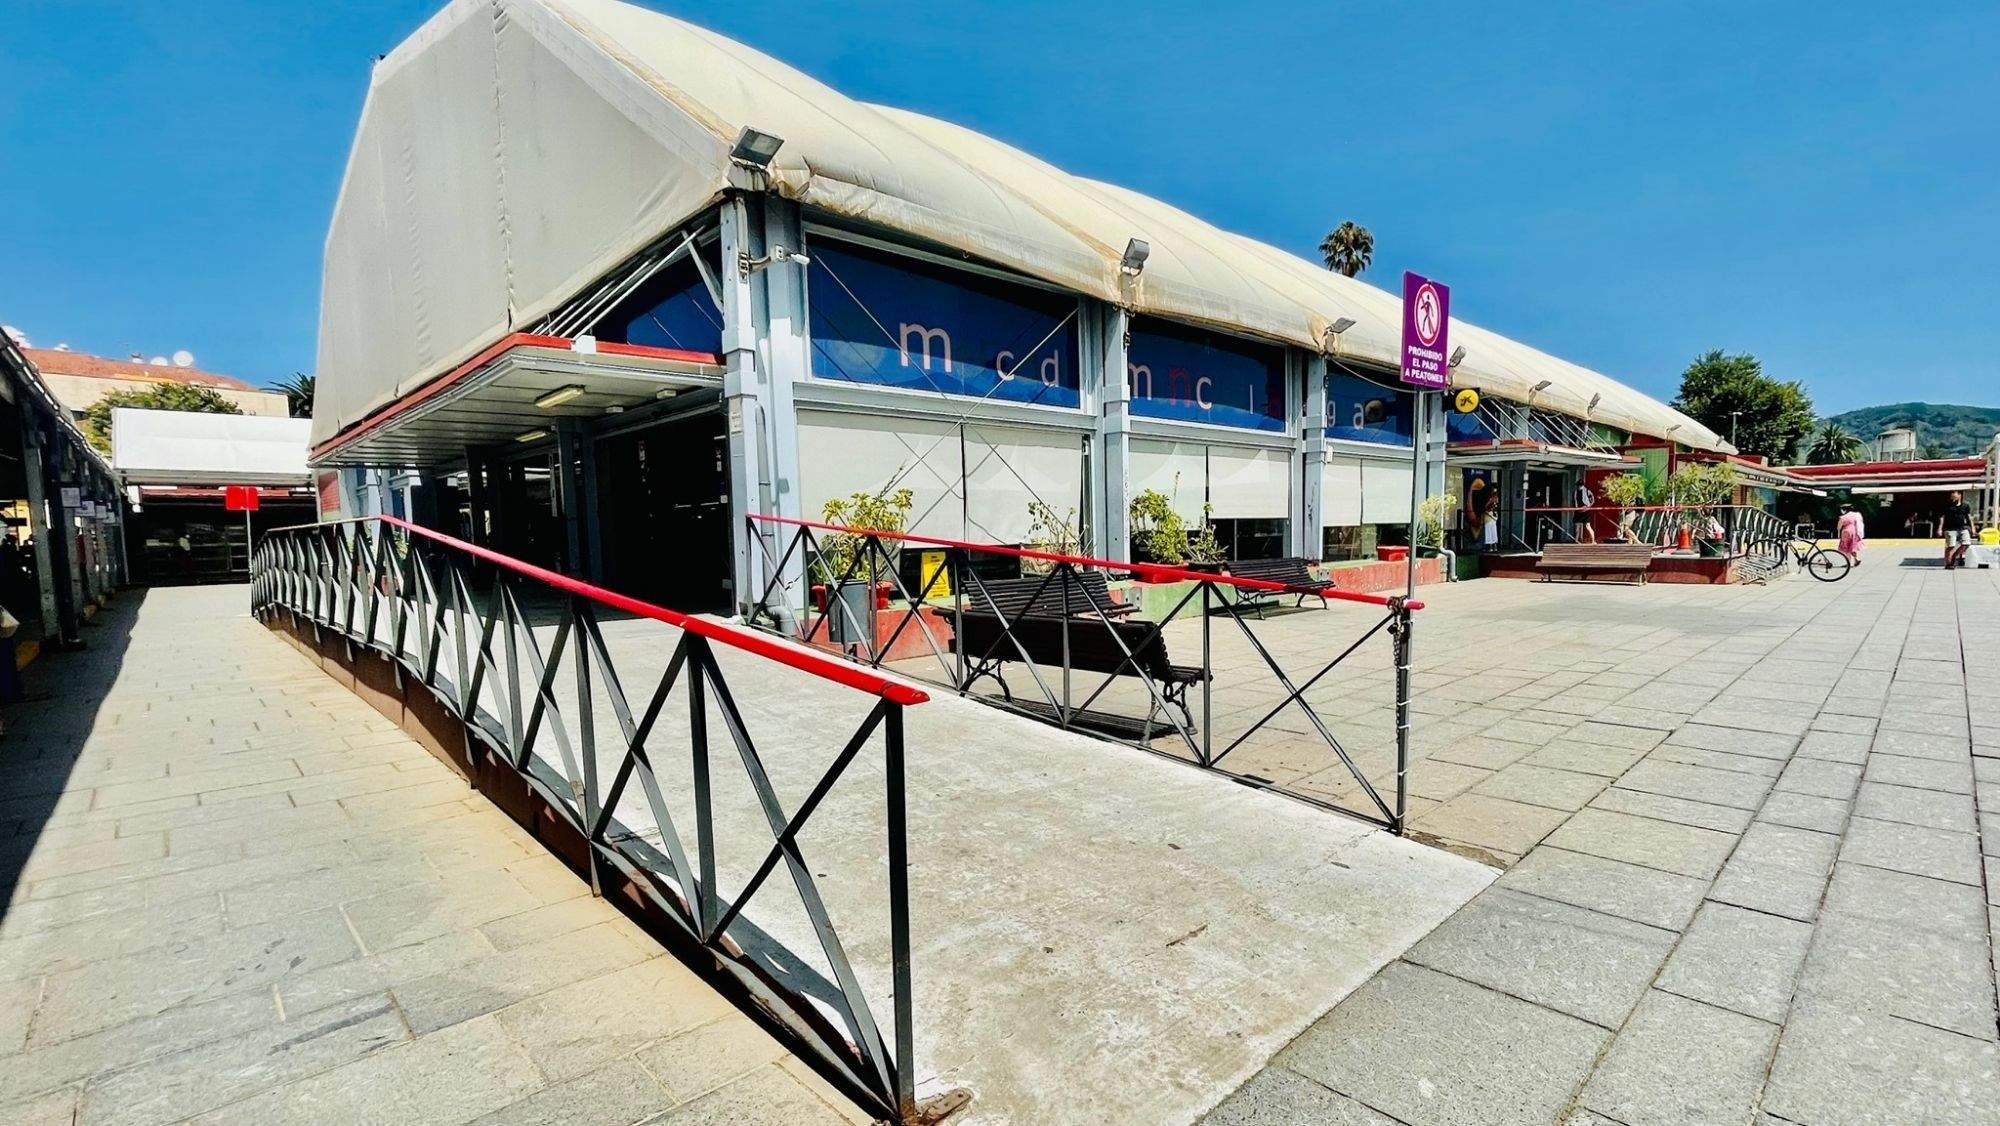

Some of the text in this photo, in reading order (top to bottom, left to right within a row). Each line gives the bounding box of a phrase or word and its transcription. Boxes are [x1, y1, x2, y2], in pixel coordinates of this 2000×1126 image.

[1408, 345, 1442, 361] PROHIBIDO
[1412, 358, 1438, 371] EL PASO
[1405, 368, 1443, 383] A PEATONES
